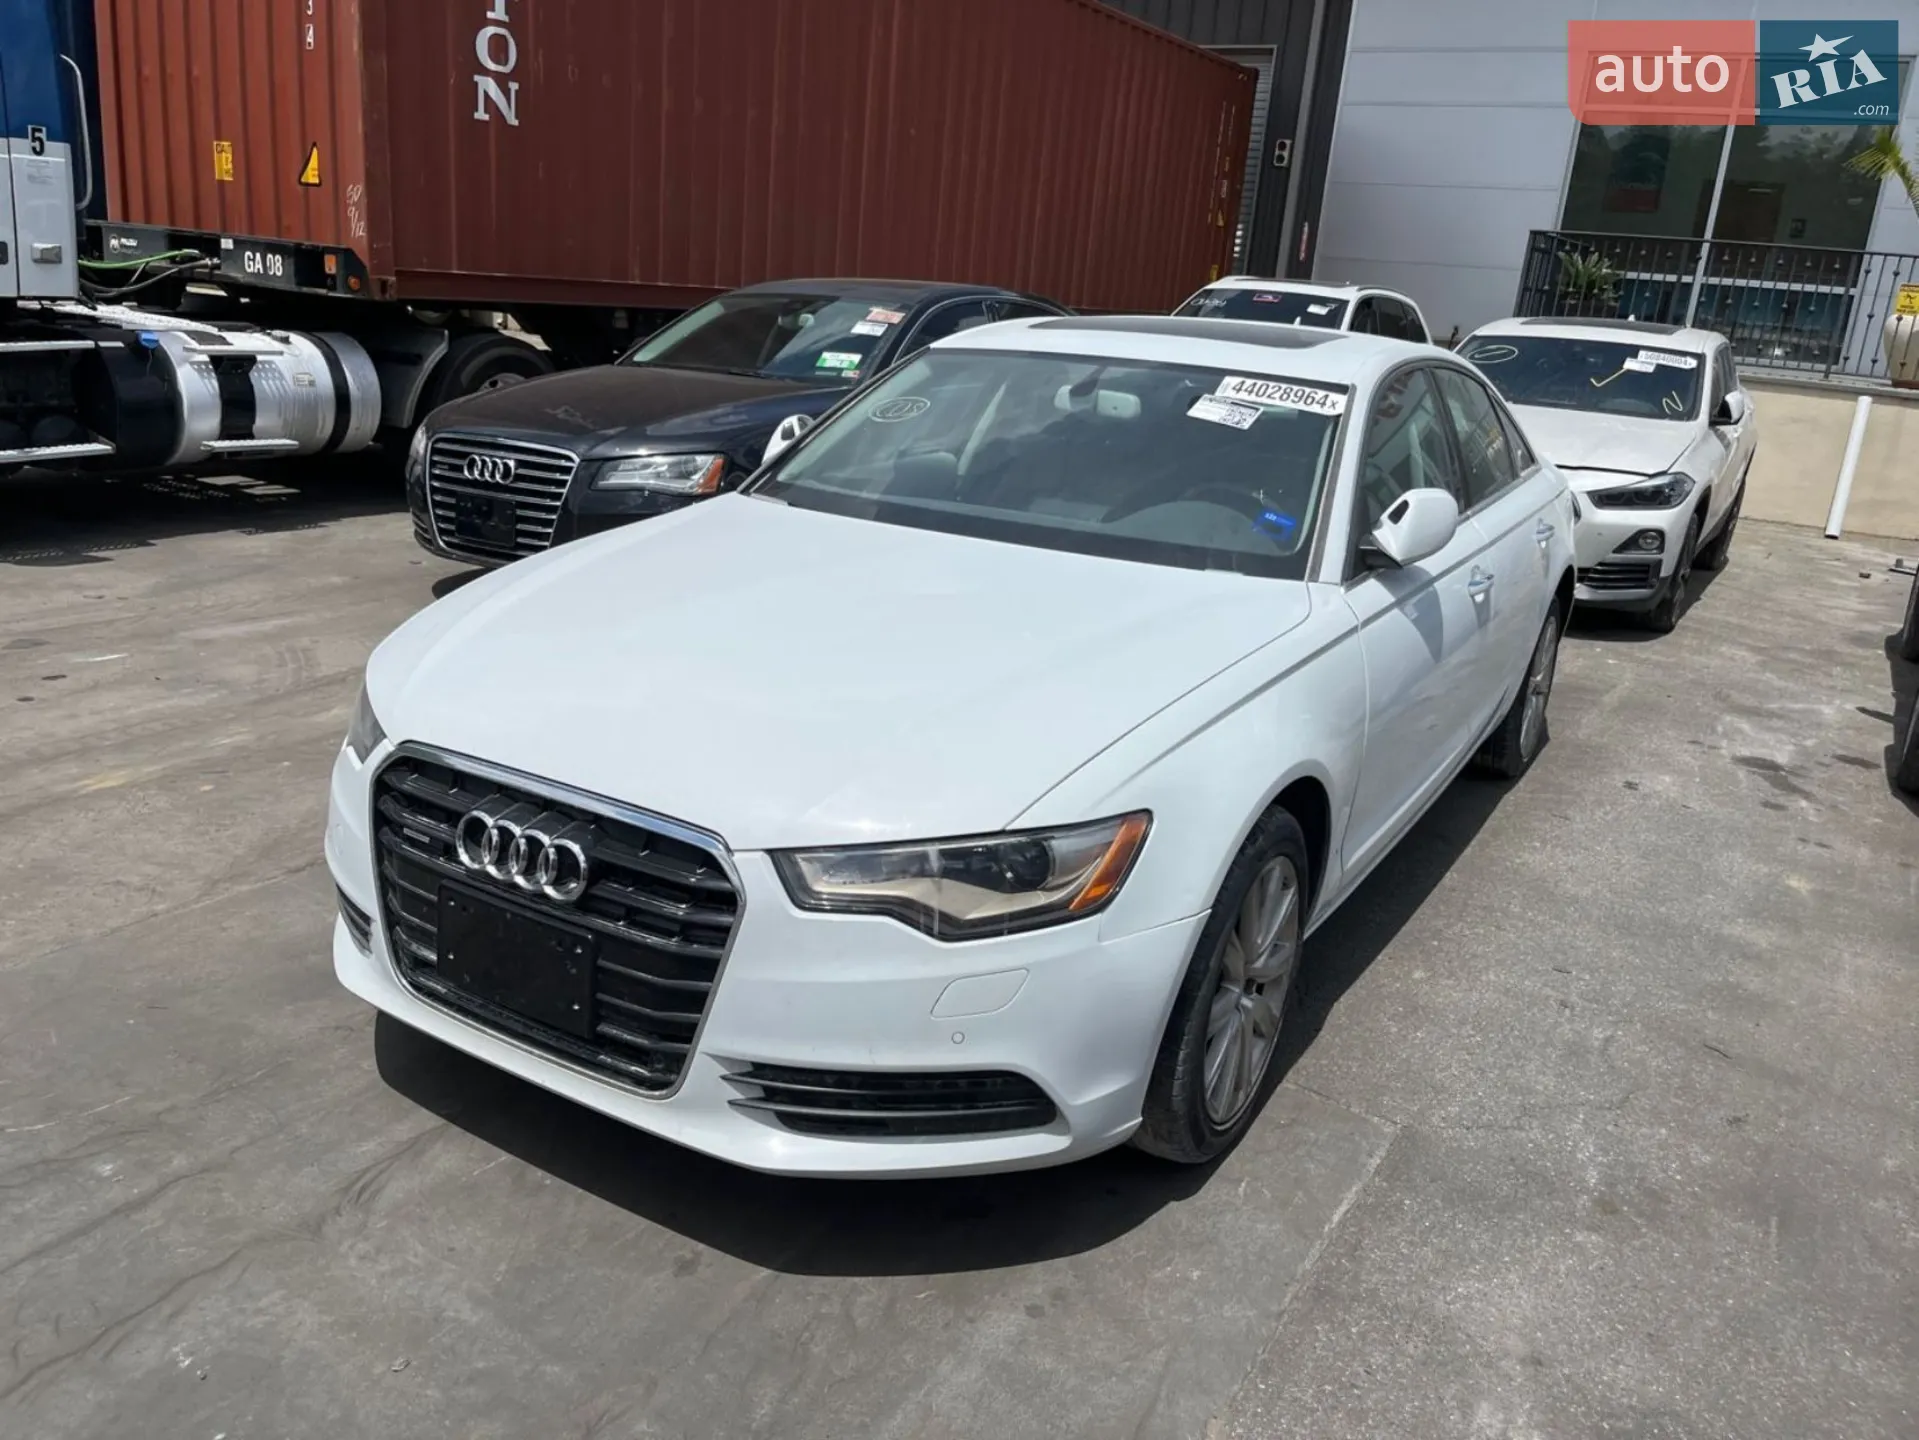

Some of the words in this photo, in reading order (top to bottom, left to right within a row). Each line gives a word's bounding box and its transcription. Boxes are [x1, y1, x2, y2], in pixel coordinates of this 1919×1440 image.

[30, 126, 45, 157] 5
[244, 251, 263, 274] GA
[266, 253, 283, 277] 08
